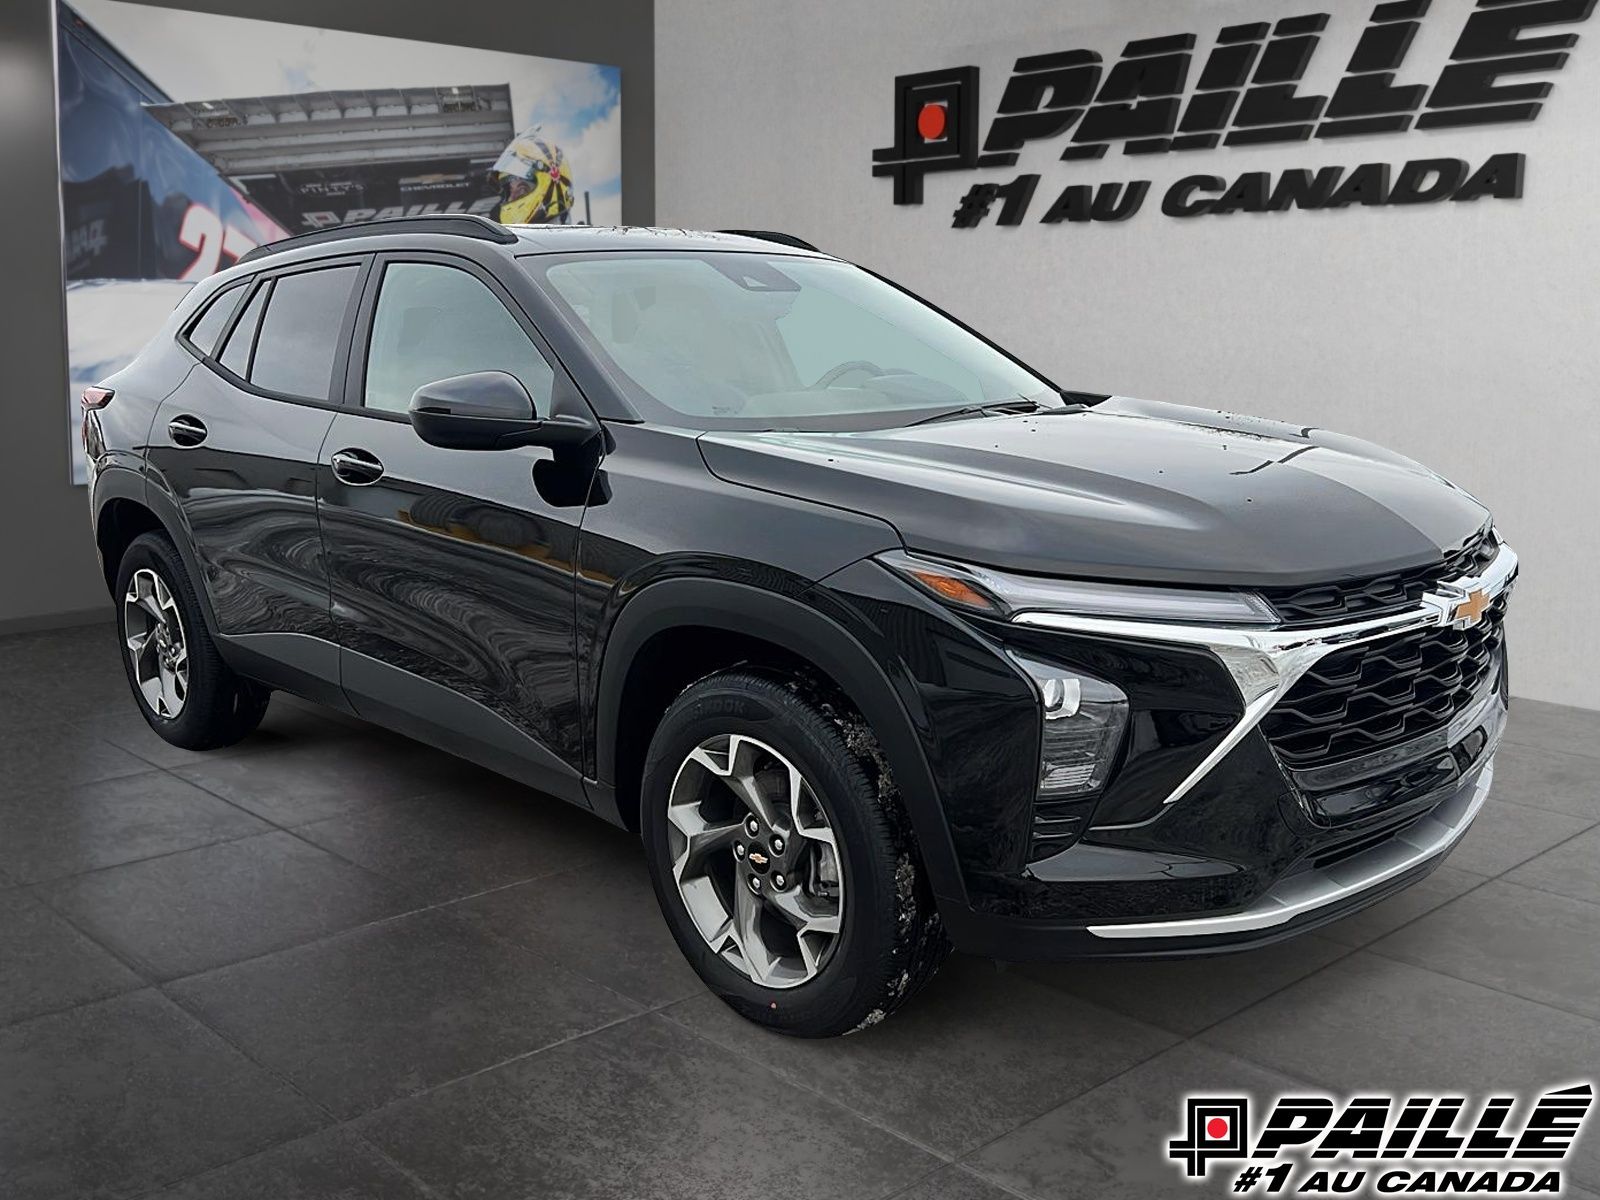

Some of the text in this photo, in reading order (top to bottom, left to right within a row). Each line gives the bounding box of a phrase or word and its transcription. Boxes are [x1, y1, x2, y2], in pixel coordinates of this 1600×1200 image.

[951, 153, 1526, 228] #1 AU CANADA
